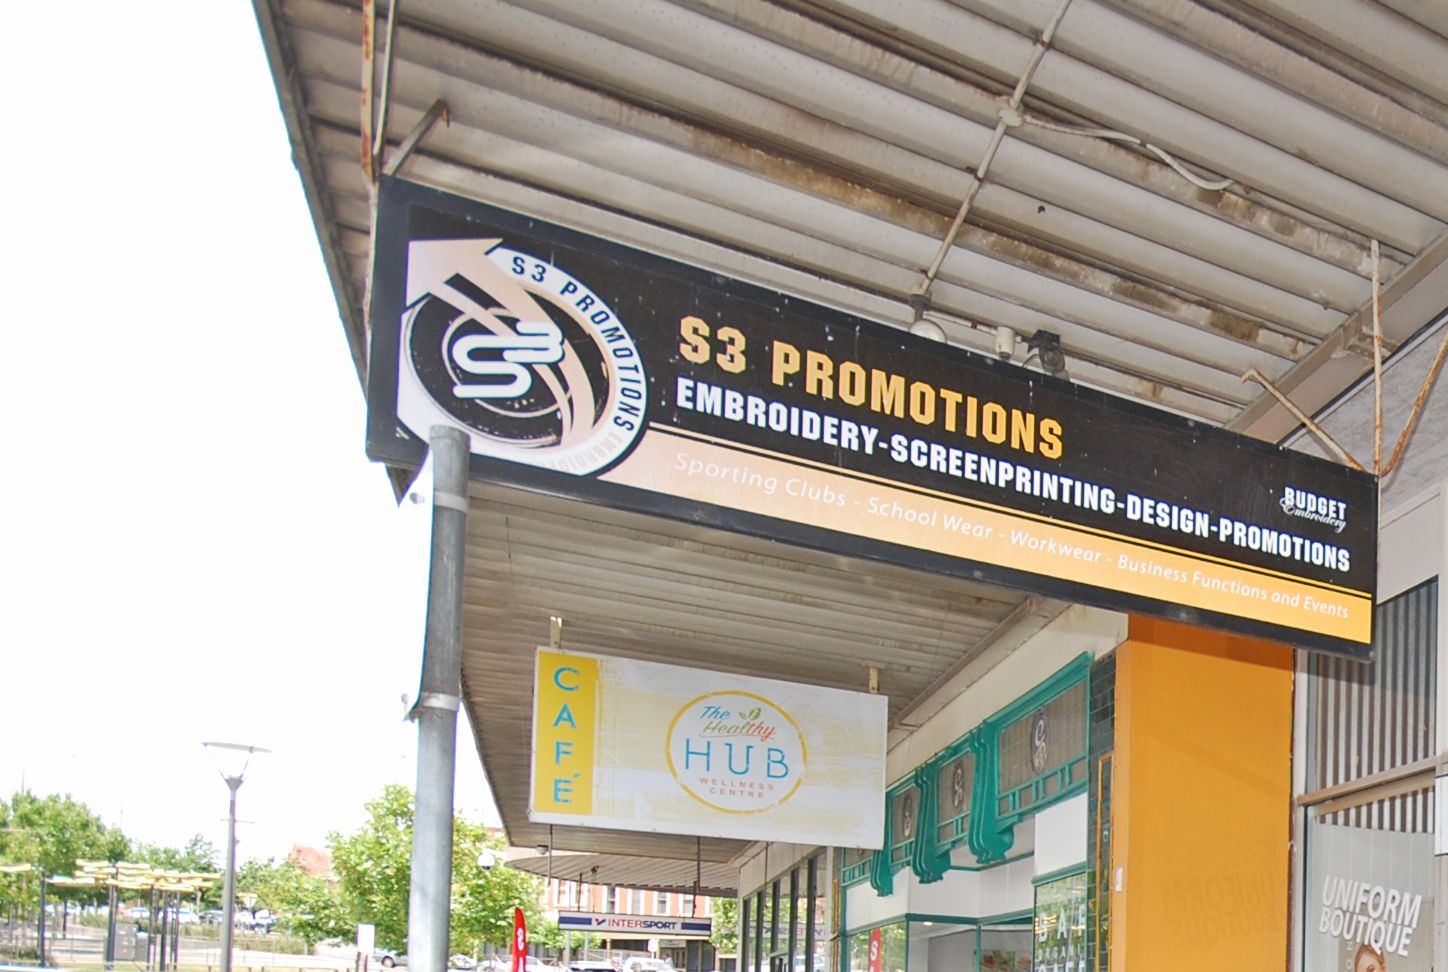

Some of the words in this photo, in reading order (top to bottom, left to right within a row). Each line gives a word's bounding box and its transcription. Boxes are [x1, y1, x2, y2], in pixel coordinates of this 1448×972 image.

[510, 255, 547, 284] S3
[559, 280, 644, 432] PROMOTIONS
[678, 314, 748, 375] S3
[770, 338, 1065, 461] PROMOTIONS
[1279, 495, 1348, 534] Embroidery
[1283, 486, 1348, 521] BUDGET
[674, 451, 778, 494] Sporting
[785, 478, 847, 508] Clubs
[866, 495, 937, 528] School
[942, 513, 994, 541] Wear
[1010, 528, 1103, 565] Workwear
[1117, 553, 1189, 585] Business
[1192, 570, 1268, 602] Functions
[1271, 590, 1300, 610] and
[1303, 597, 1350, 620] Events
[700, 705, 731, 720] The
[702, 720, 776, 742] Healthy
[684, 737, 789, 780] HUB
[699, 776, 775, 791] WELLNESS
[709, 787, 765, 799] CENTRE
[1321, 874, 1423, 929] UNIFORM
[607, 918, 677, 930] INTERSPORT
[1319, 906, 1414, 958] BOUTIQUE
